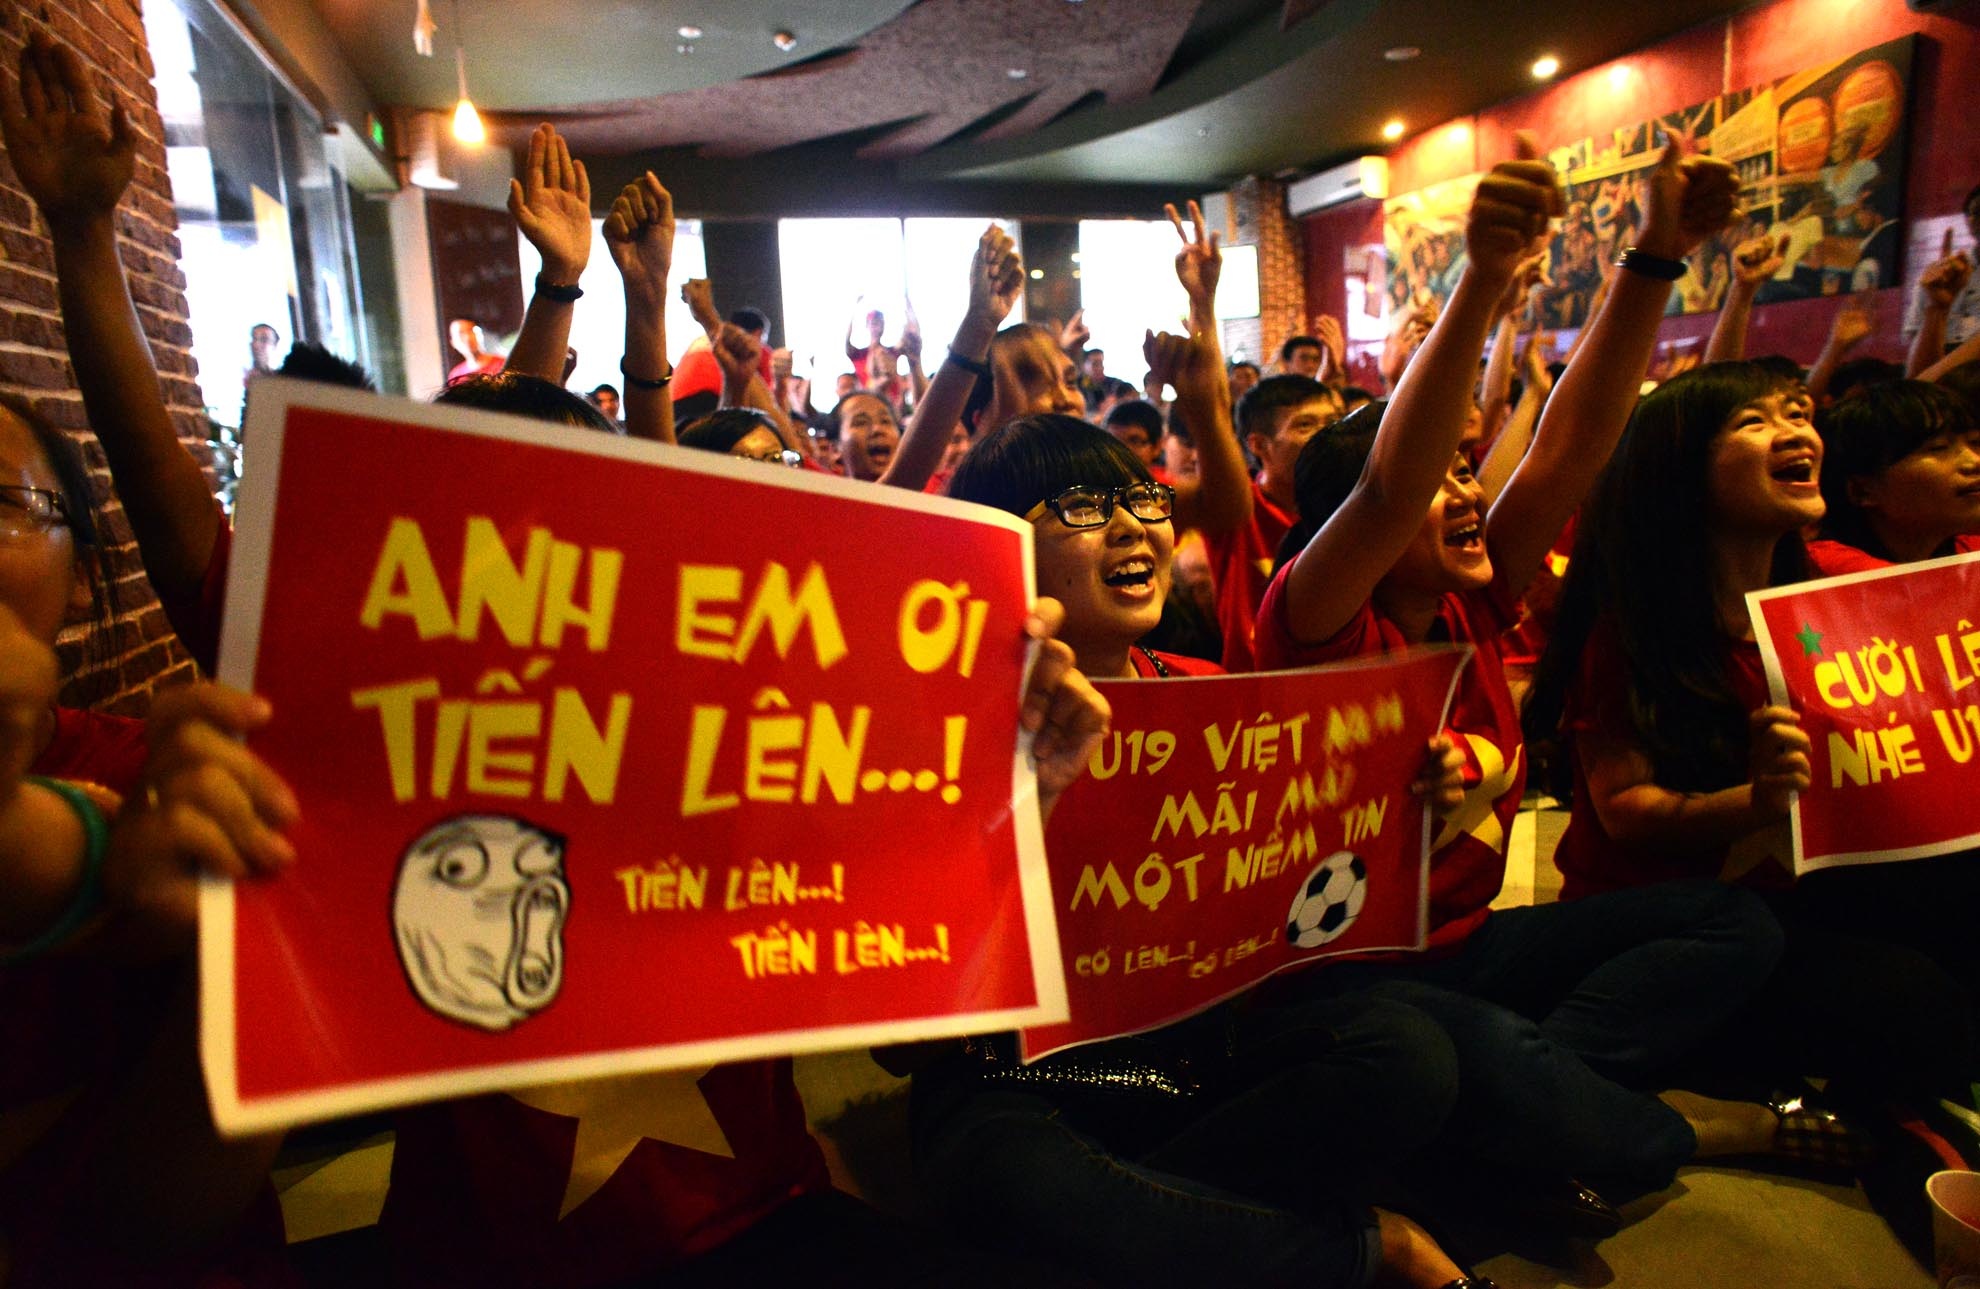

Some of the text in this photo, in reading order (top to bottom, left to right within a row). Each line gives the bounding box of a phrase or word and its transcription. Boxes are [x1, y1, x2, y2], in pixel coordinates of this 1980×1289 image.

[360, 516, 988, 678] ANH EM ƠI
[1813, 636, 1926, 709] CƯỜI
[350, 658, 968, 816] TIẾN LÊN...!
[1088, 728, 1177, 781] U19
[1203, 711, 1310, 774] VIỆT
[1827, 711, 1927, 790] NHÉ
[1151, 781, 1258, 843] MÃI
[615, 853, 845, 912] TIẾN LÊN...!
[1070, 796, 1389, 912] MỘT NIỀM TIN
[730, 919, 950, 979] TIẾN LÊN...!
[1075, 945, 1111, 977] CỐ
